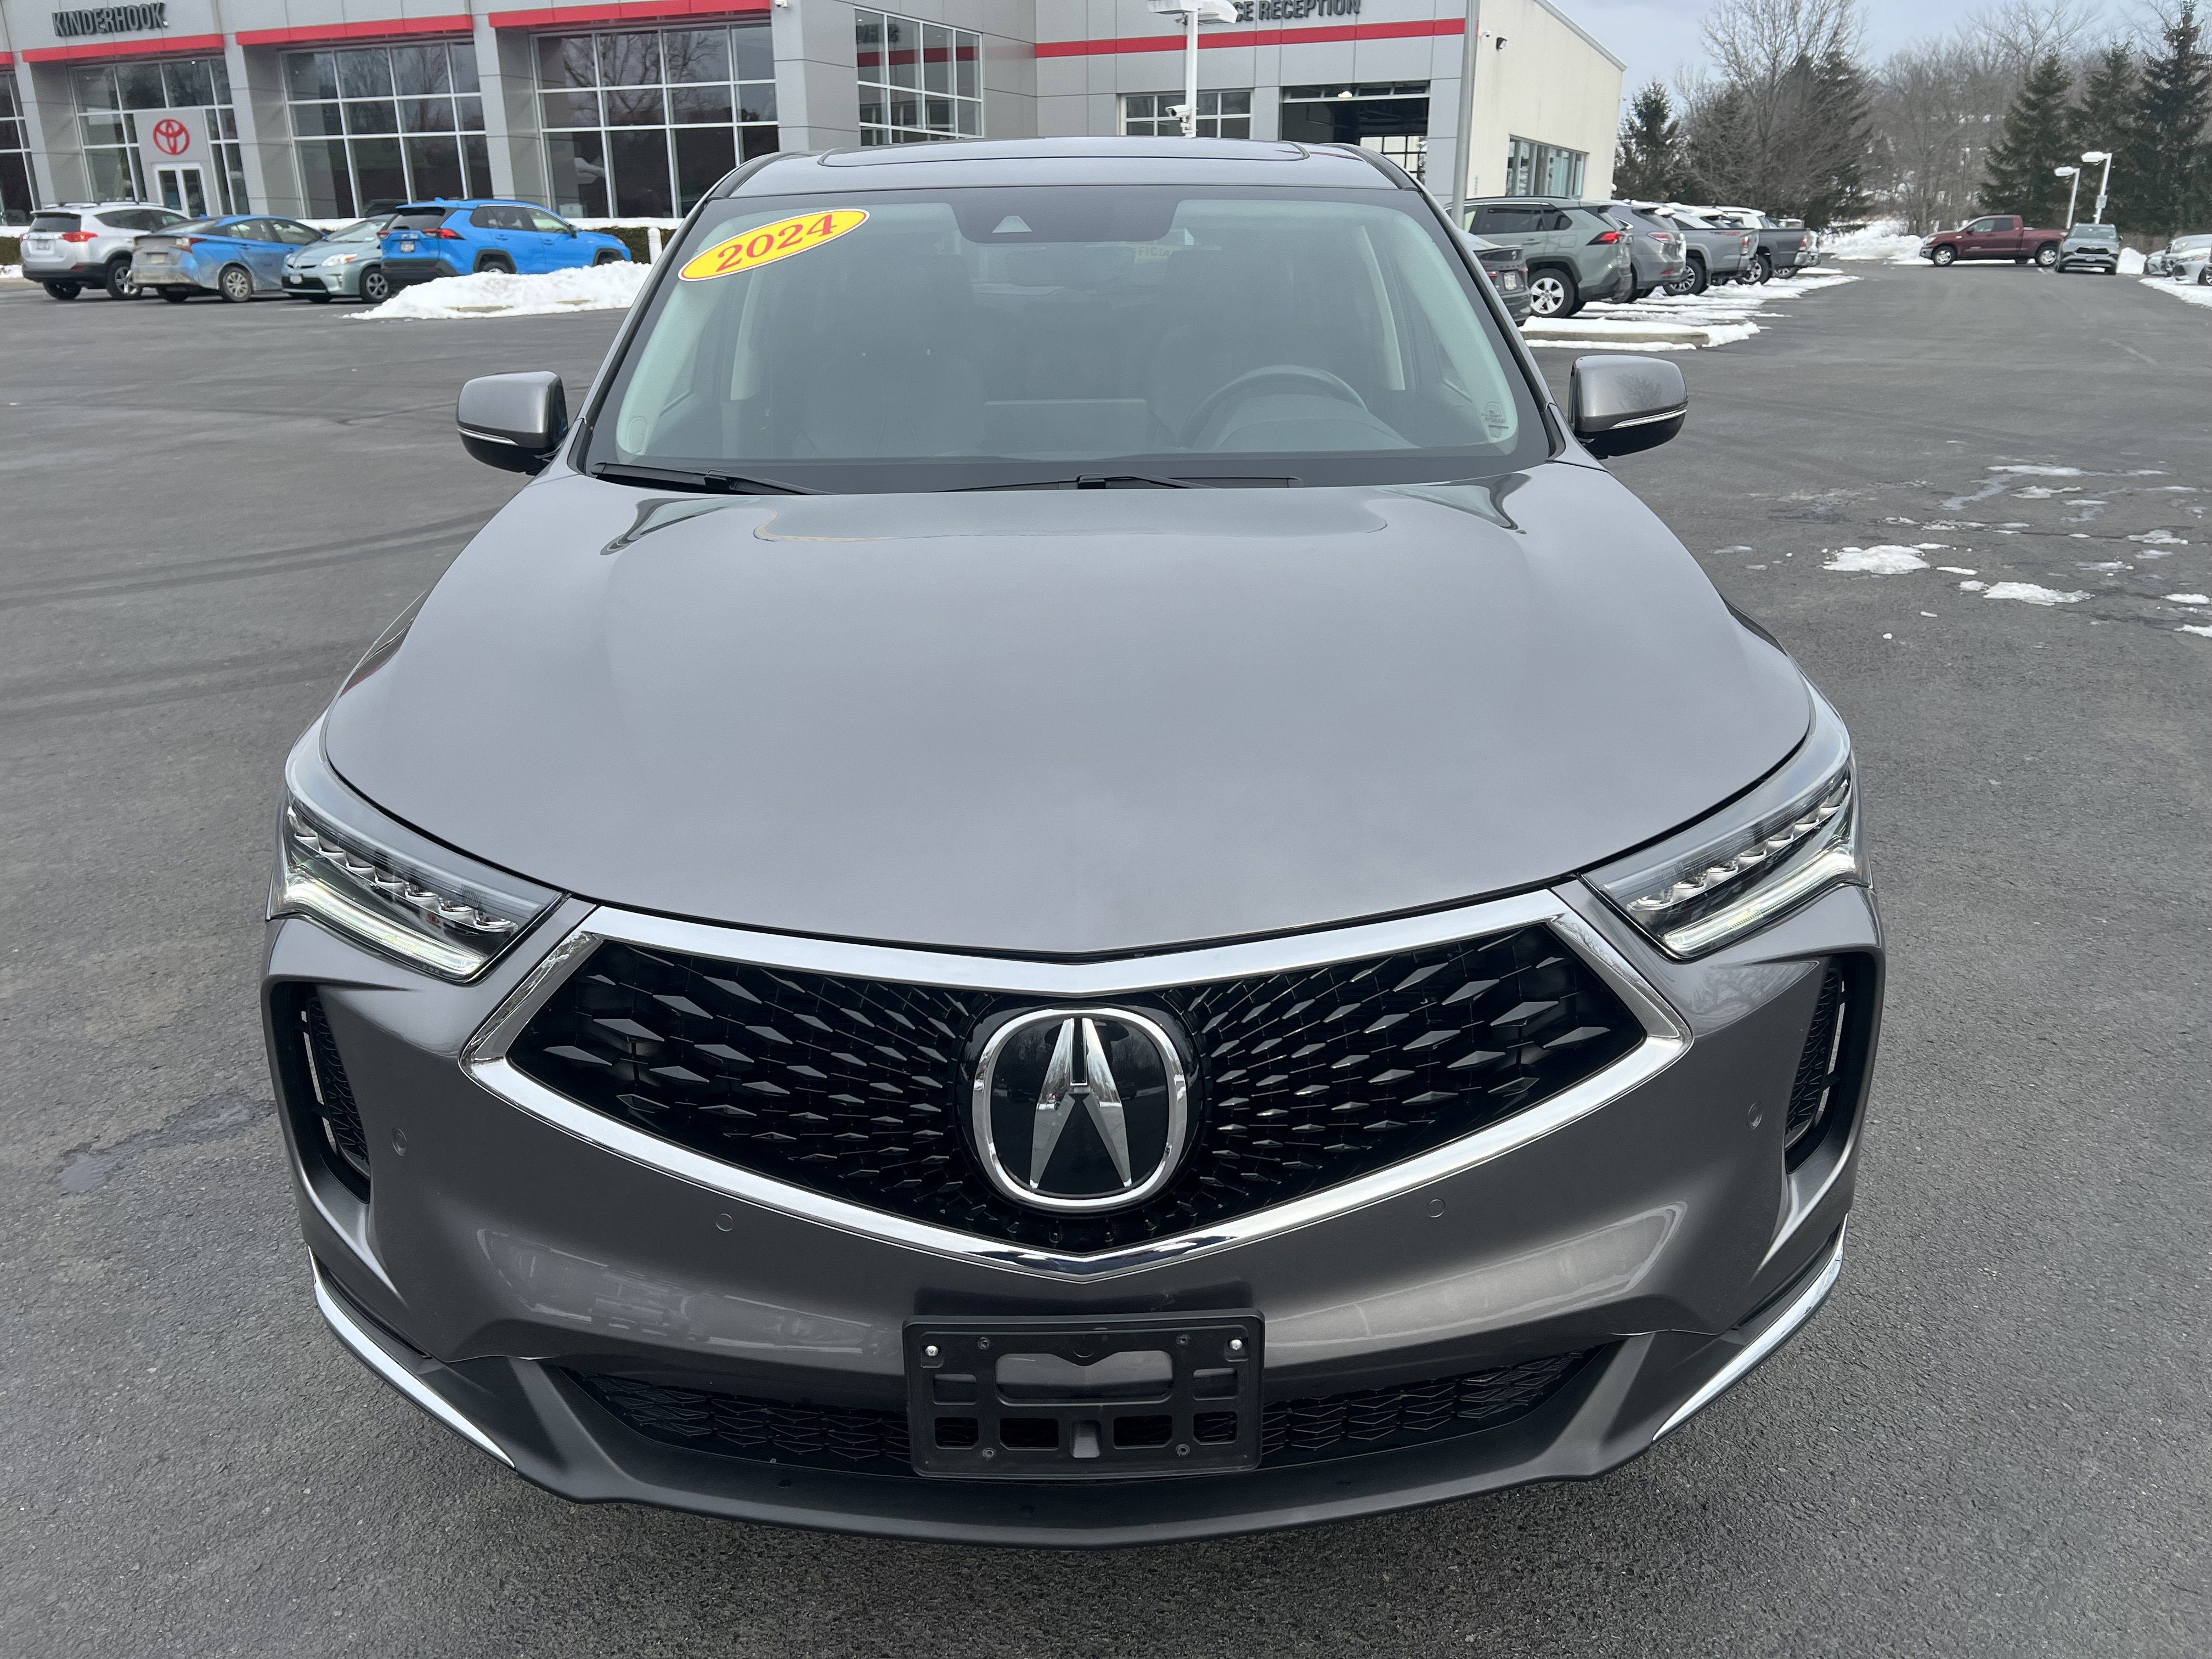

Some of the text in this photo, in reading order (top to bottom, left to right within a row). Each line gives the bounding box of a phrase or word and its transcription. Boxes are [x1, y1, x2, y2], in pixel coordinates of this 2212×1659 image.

[52, 2, 166, 37] KINDERHOOK
[1259, 0, 1361, 20] RECEPTION
[716, 214, 838, 273] 2024
